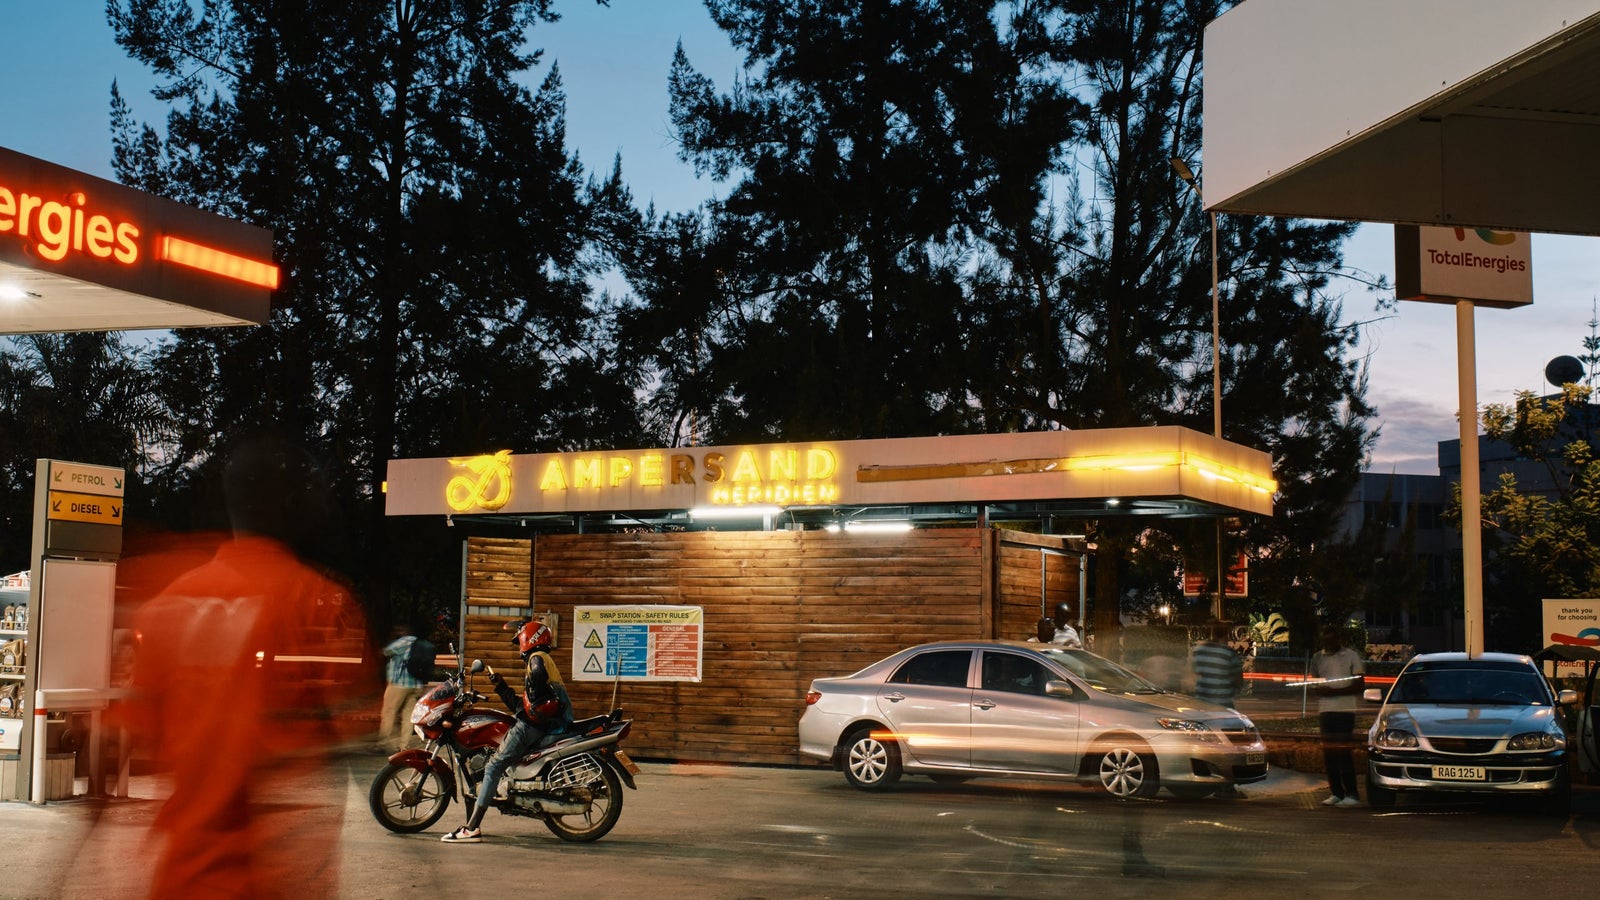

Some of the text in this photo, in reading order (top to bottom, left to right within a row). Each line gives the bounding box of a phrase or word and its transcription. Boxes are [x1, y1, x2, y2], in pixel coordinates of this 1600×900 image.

[1427, 249, 1526, 274] TotalEnergies
[540, 449, 836, 490] AMPERSAND
[71, 473, 106, 486] PETROL
[712, 485, 837, 504] MERIDIEN
[70, 502, 103, 515] DIESEL
[1438, 767, 1483, 778] RAG 125 L
